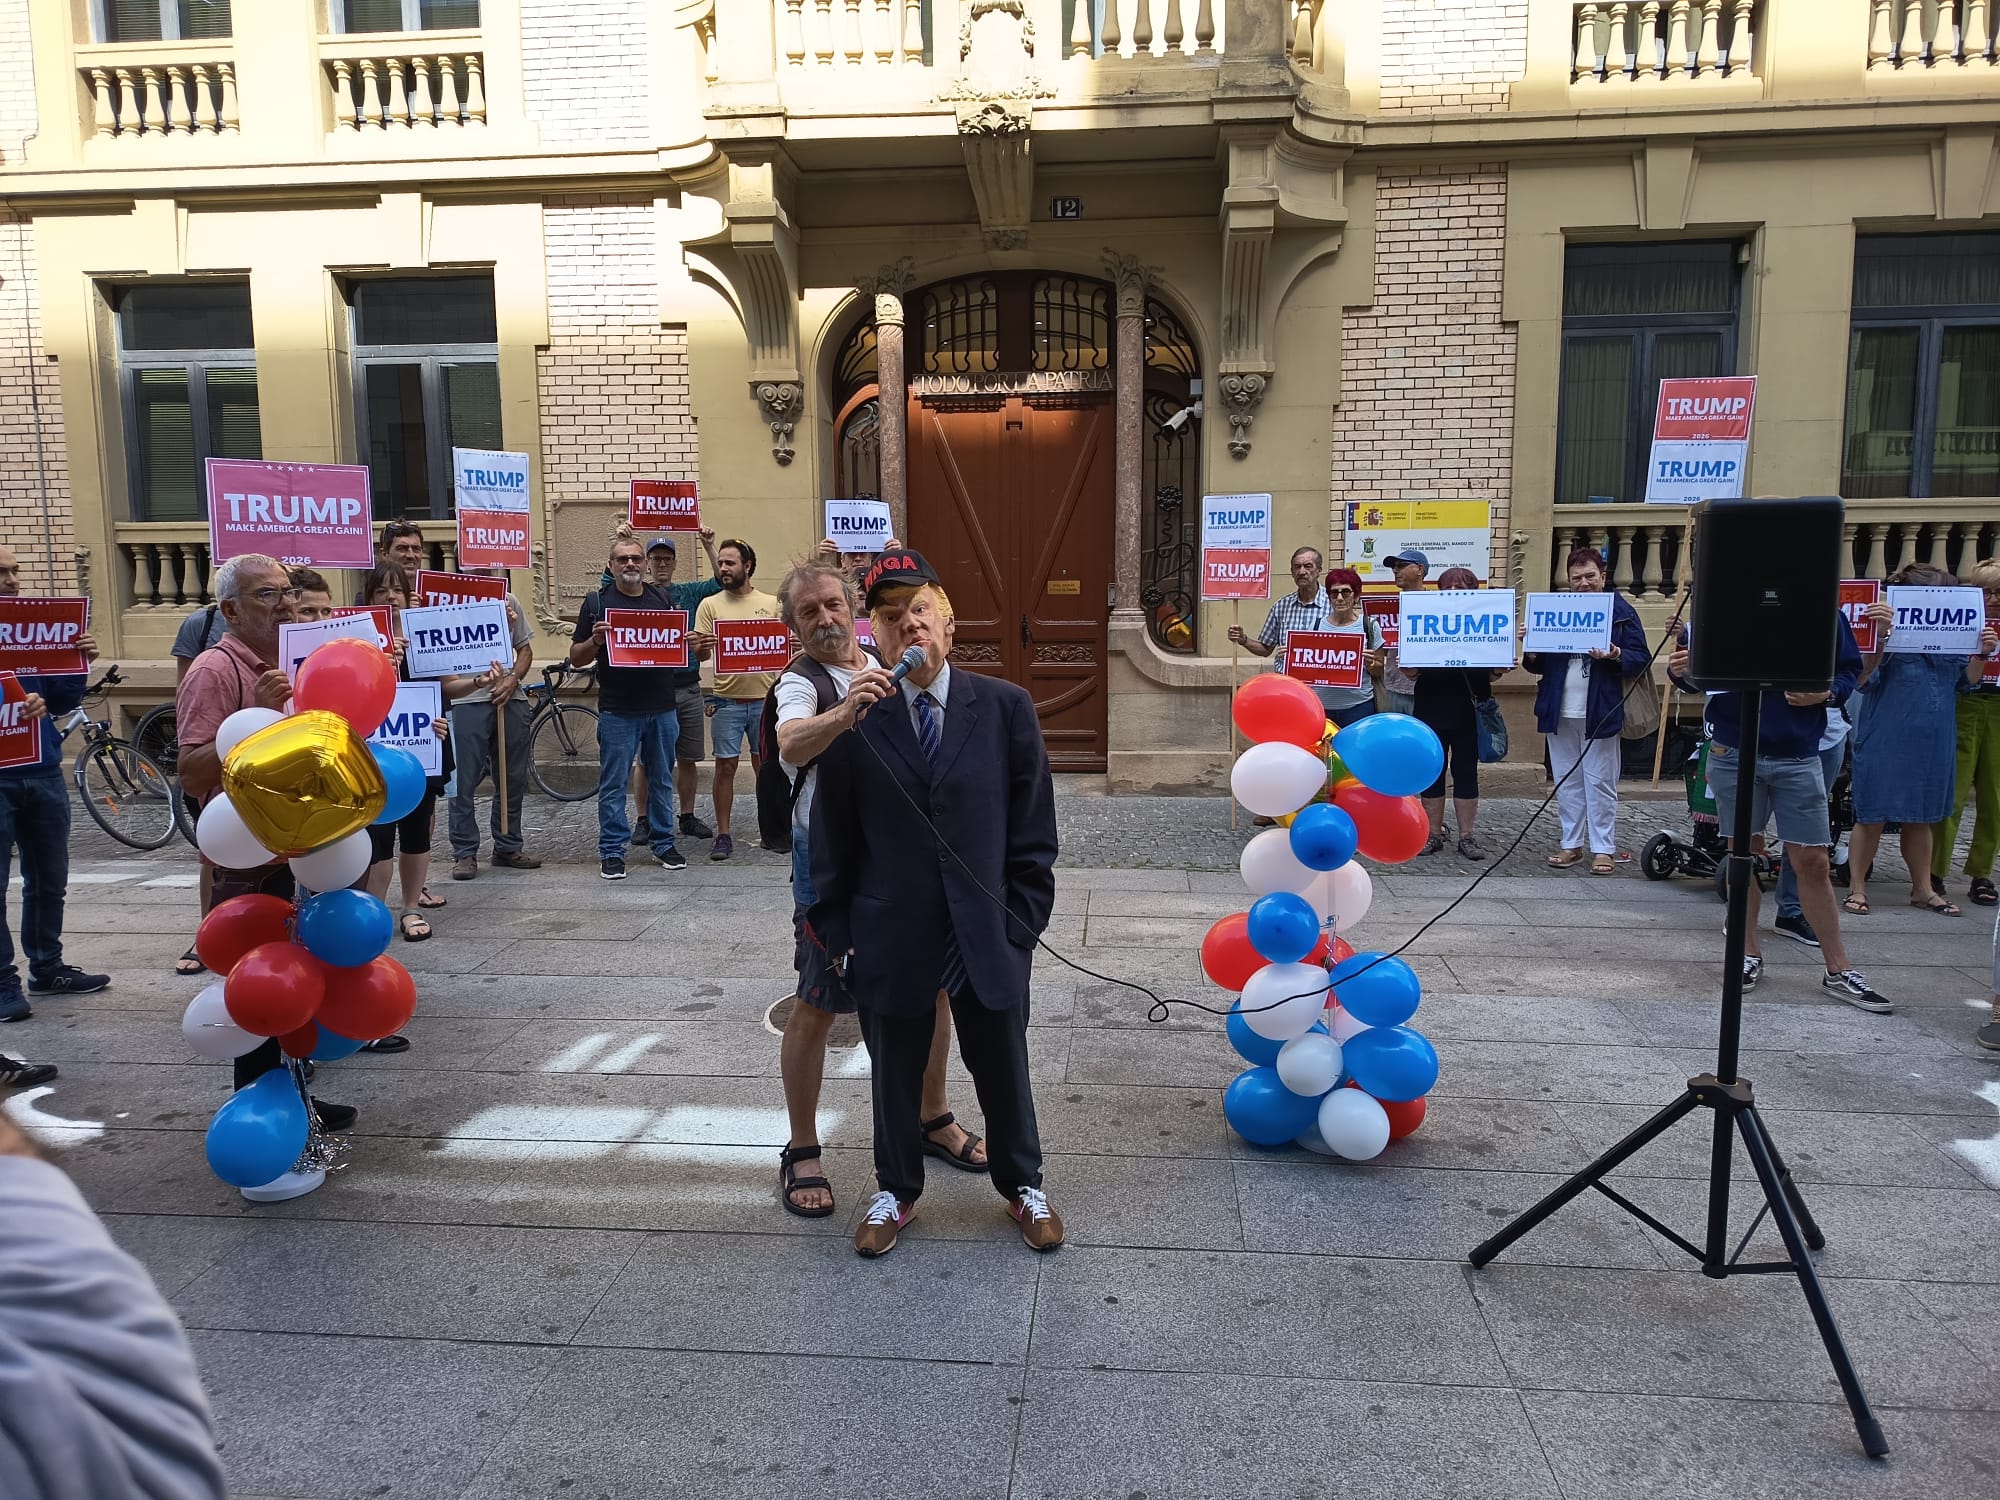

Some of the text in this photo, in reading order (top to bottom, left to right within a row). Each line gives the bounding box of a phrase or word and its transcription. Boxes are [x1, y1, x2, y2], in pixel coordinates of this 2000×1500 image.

[1056, 200, 1076, 216] 12
[915, 376, 970, 392] TODO
[1045, 371, 1112, 390] PATRIA
[1668, 398, 1746, 415] TRUMP
[1659, 461, 1736, 477] TRUMP
[464, 469, 524, 488] TRUMP
[224, 493, 361, 525] TRUMP
[636, 496, 694, 511] TRUMP
[832, 517, 886, 530] TRUMP
[1209, 510, 1265, 525] TRUMP
[225, 524, 255, 532] MAKE
[256, 524, 301, 533] AMERICA
[466, 528, 525, 545] TRUMP
[1209, 564, 1265, 577] TRUMP
[1408, 614, 1508, 635] TRUMP
[1534, 612, 1605, 627] TRUMP
[1898, 608, 1977, 625] TRUMP
[0, 623, 78, 643] RUMP
[415, 624, 499, 648] TRUMP
[614, 628, 681, 643] TRUMP
[723, 636, 786, 651] TRUMP
[1293, 648, 1357, 665] TRUMP
[6, 726, 28, 736] GAIN!
